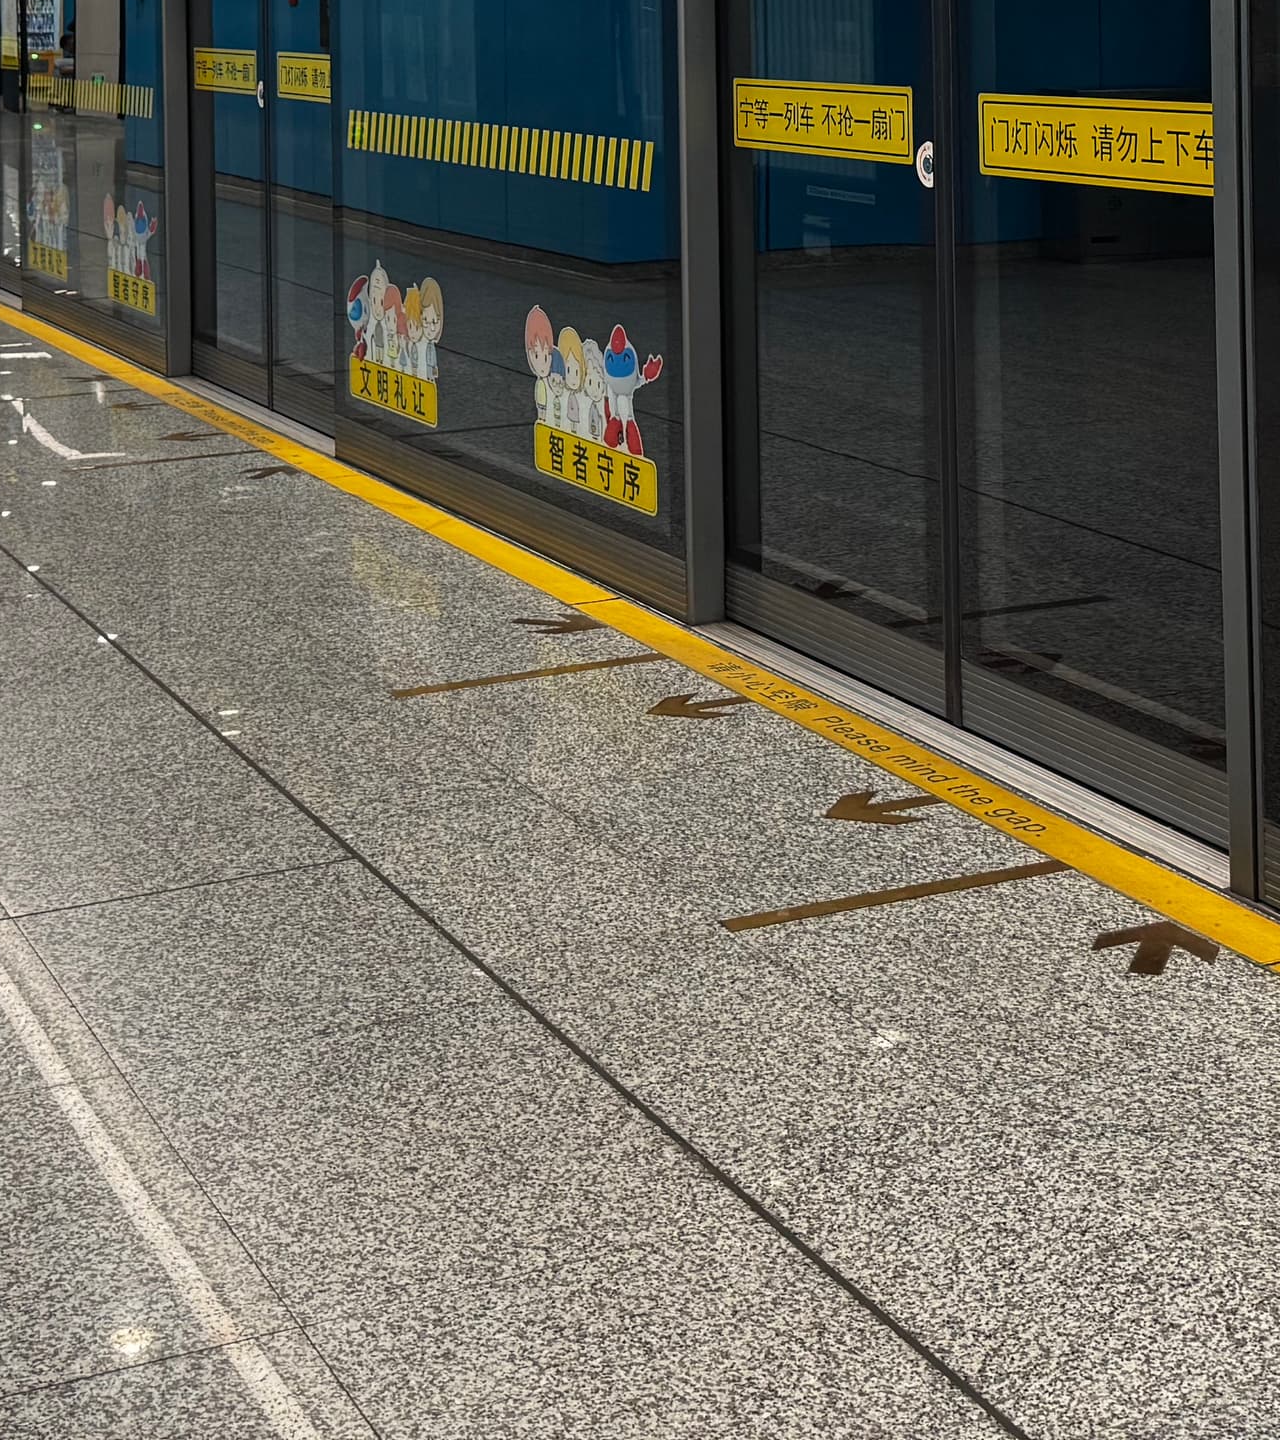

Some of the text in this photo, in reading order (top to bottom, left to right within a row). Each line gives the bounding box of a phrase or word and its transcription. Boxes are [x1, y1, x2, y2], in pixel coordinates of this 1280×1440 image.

[738, 96, 907, 143] 宁等一列车 不抢一扇门
[990, 116, 1213, 169] 门灯闪烁 请勿上下车
[359, 364, 426, 417] 文明礼让
[549, 430, 641, 502] 智者守序
[706, 661, 1049, 838] 请小心空隙 Please mind the gap.
